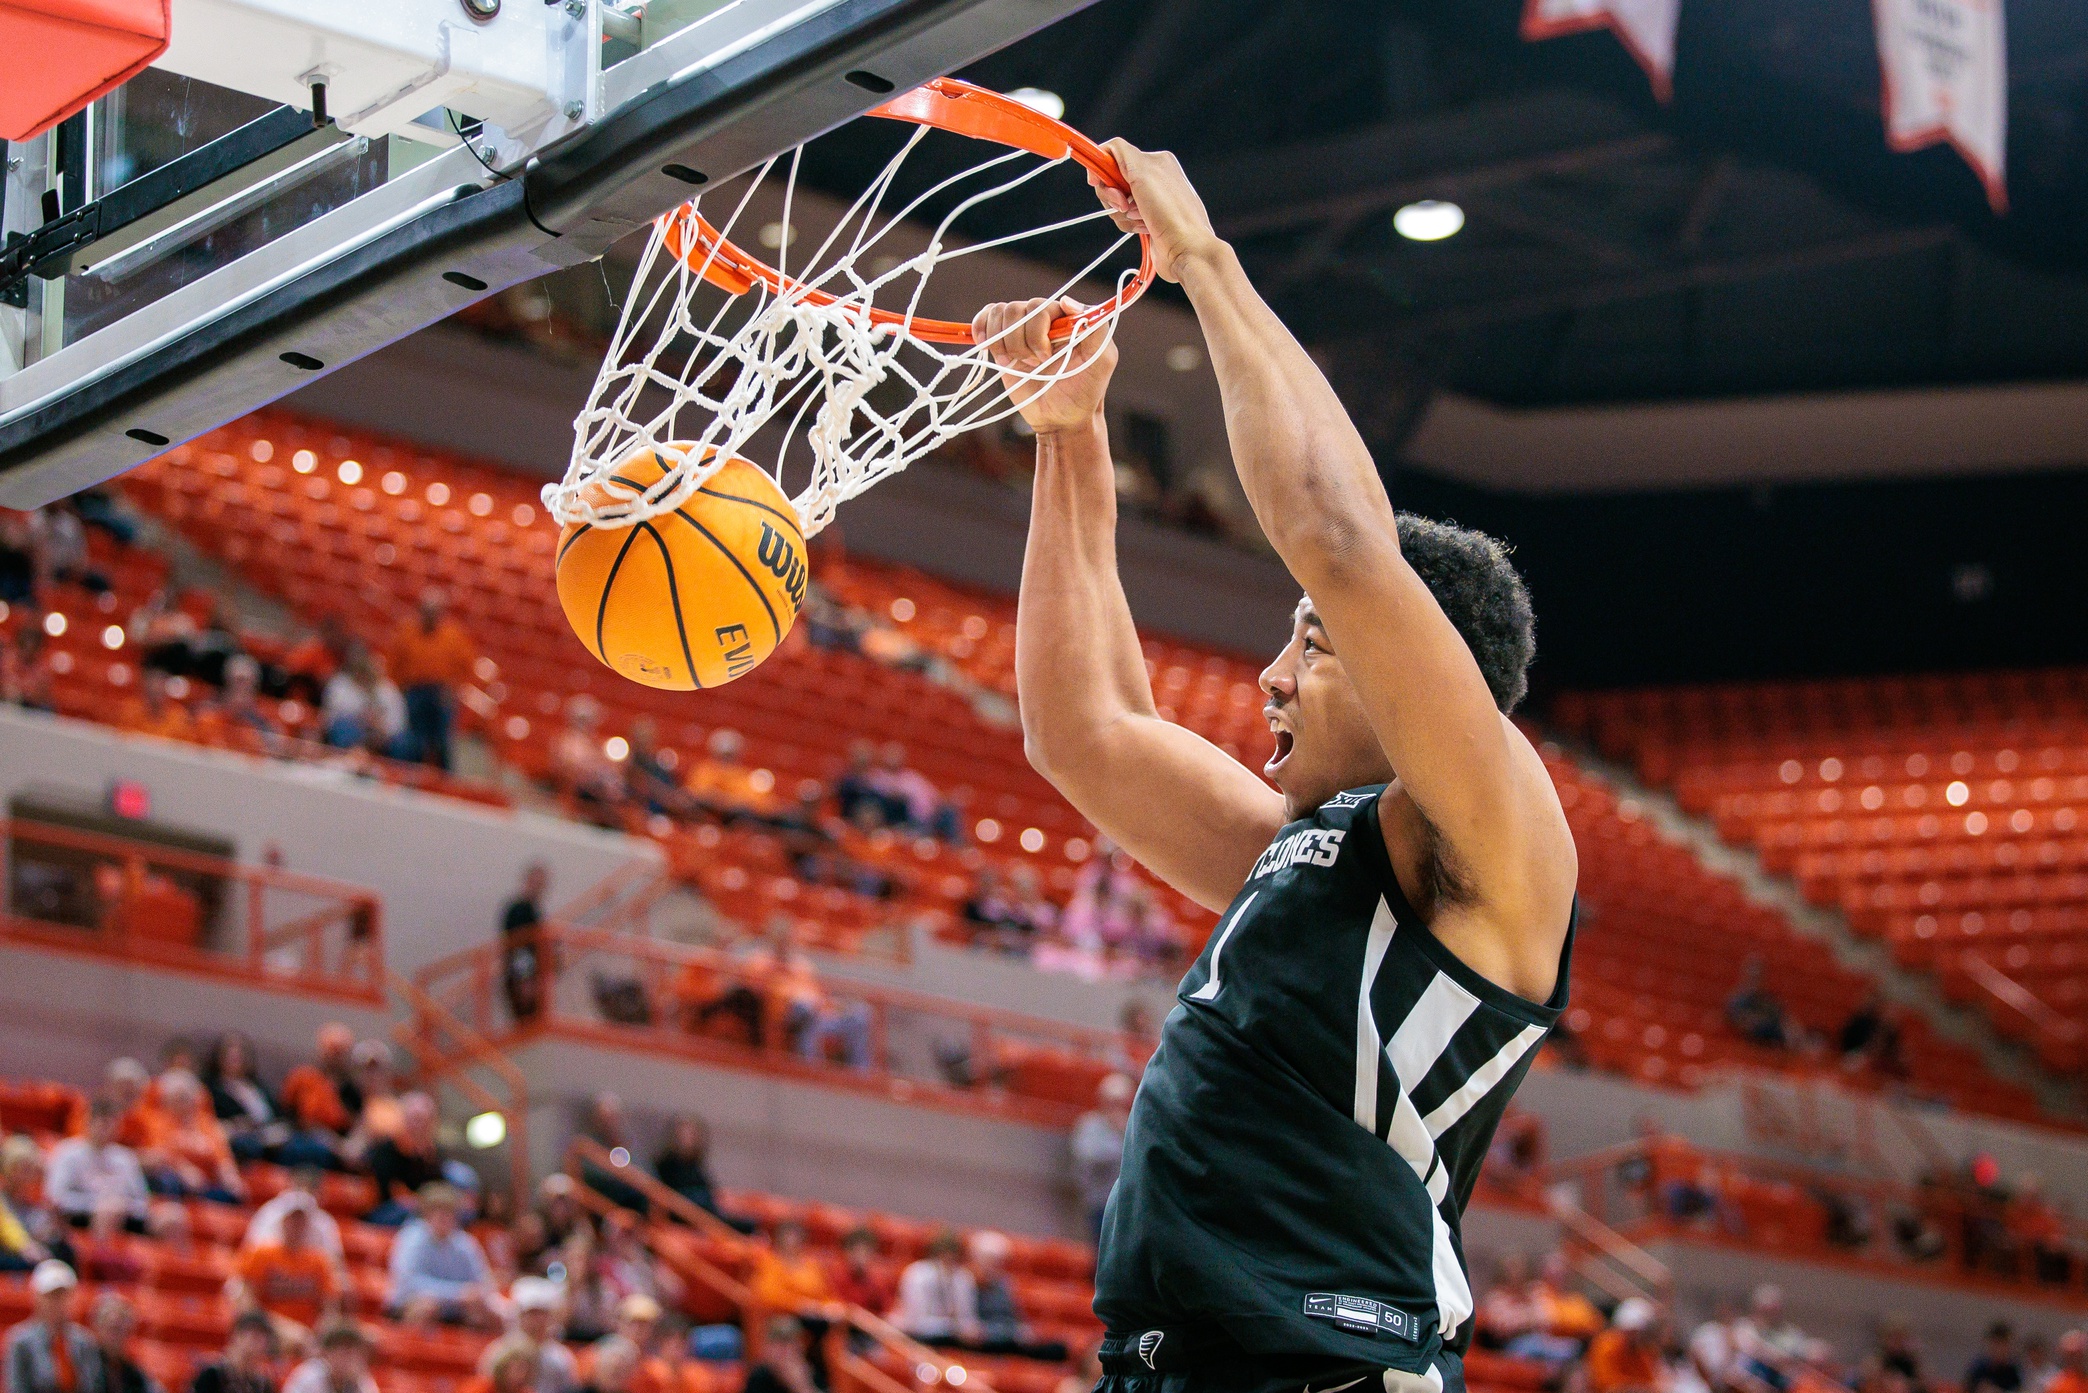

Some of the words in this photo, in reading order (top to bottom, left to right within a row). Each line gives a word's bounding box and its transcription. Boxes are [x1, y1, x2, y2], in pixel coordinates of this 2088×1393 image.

[1244, 828, 1347, 885] CLONES
[1190, 890, 1259, 1000] 1
[1308, 1304, 1333, 1312] TEAM
[1384, 1311, 1402, 1327] 50
